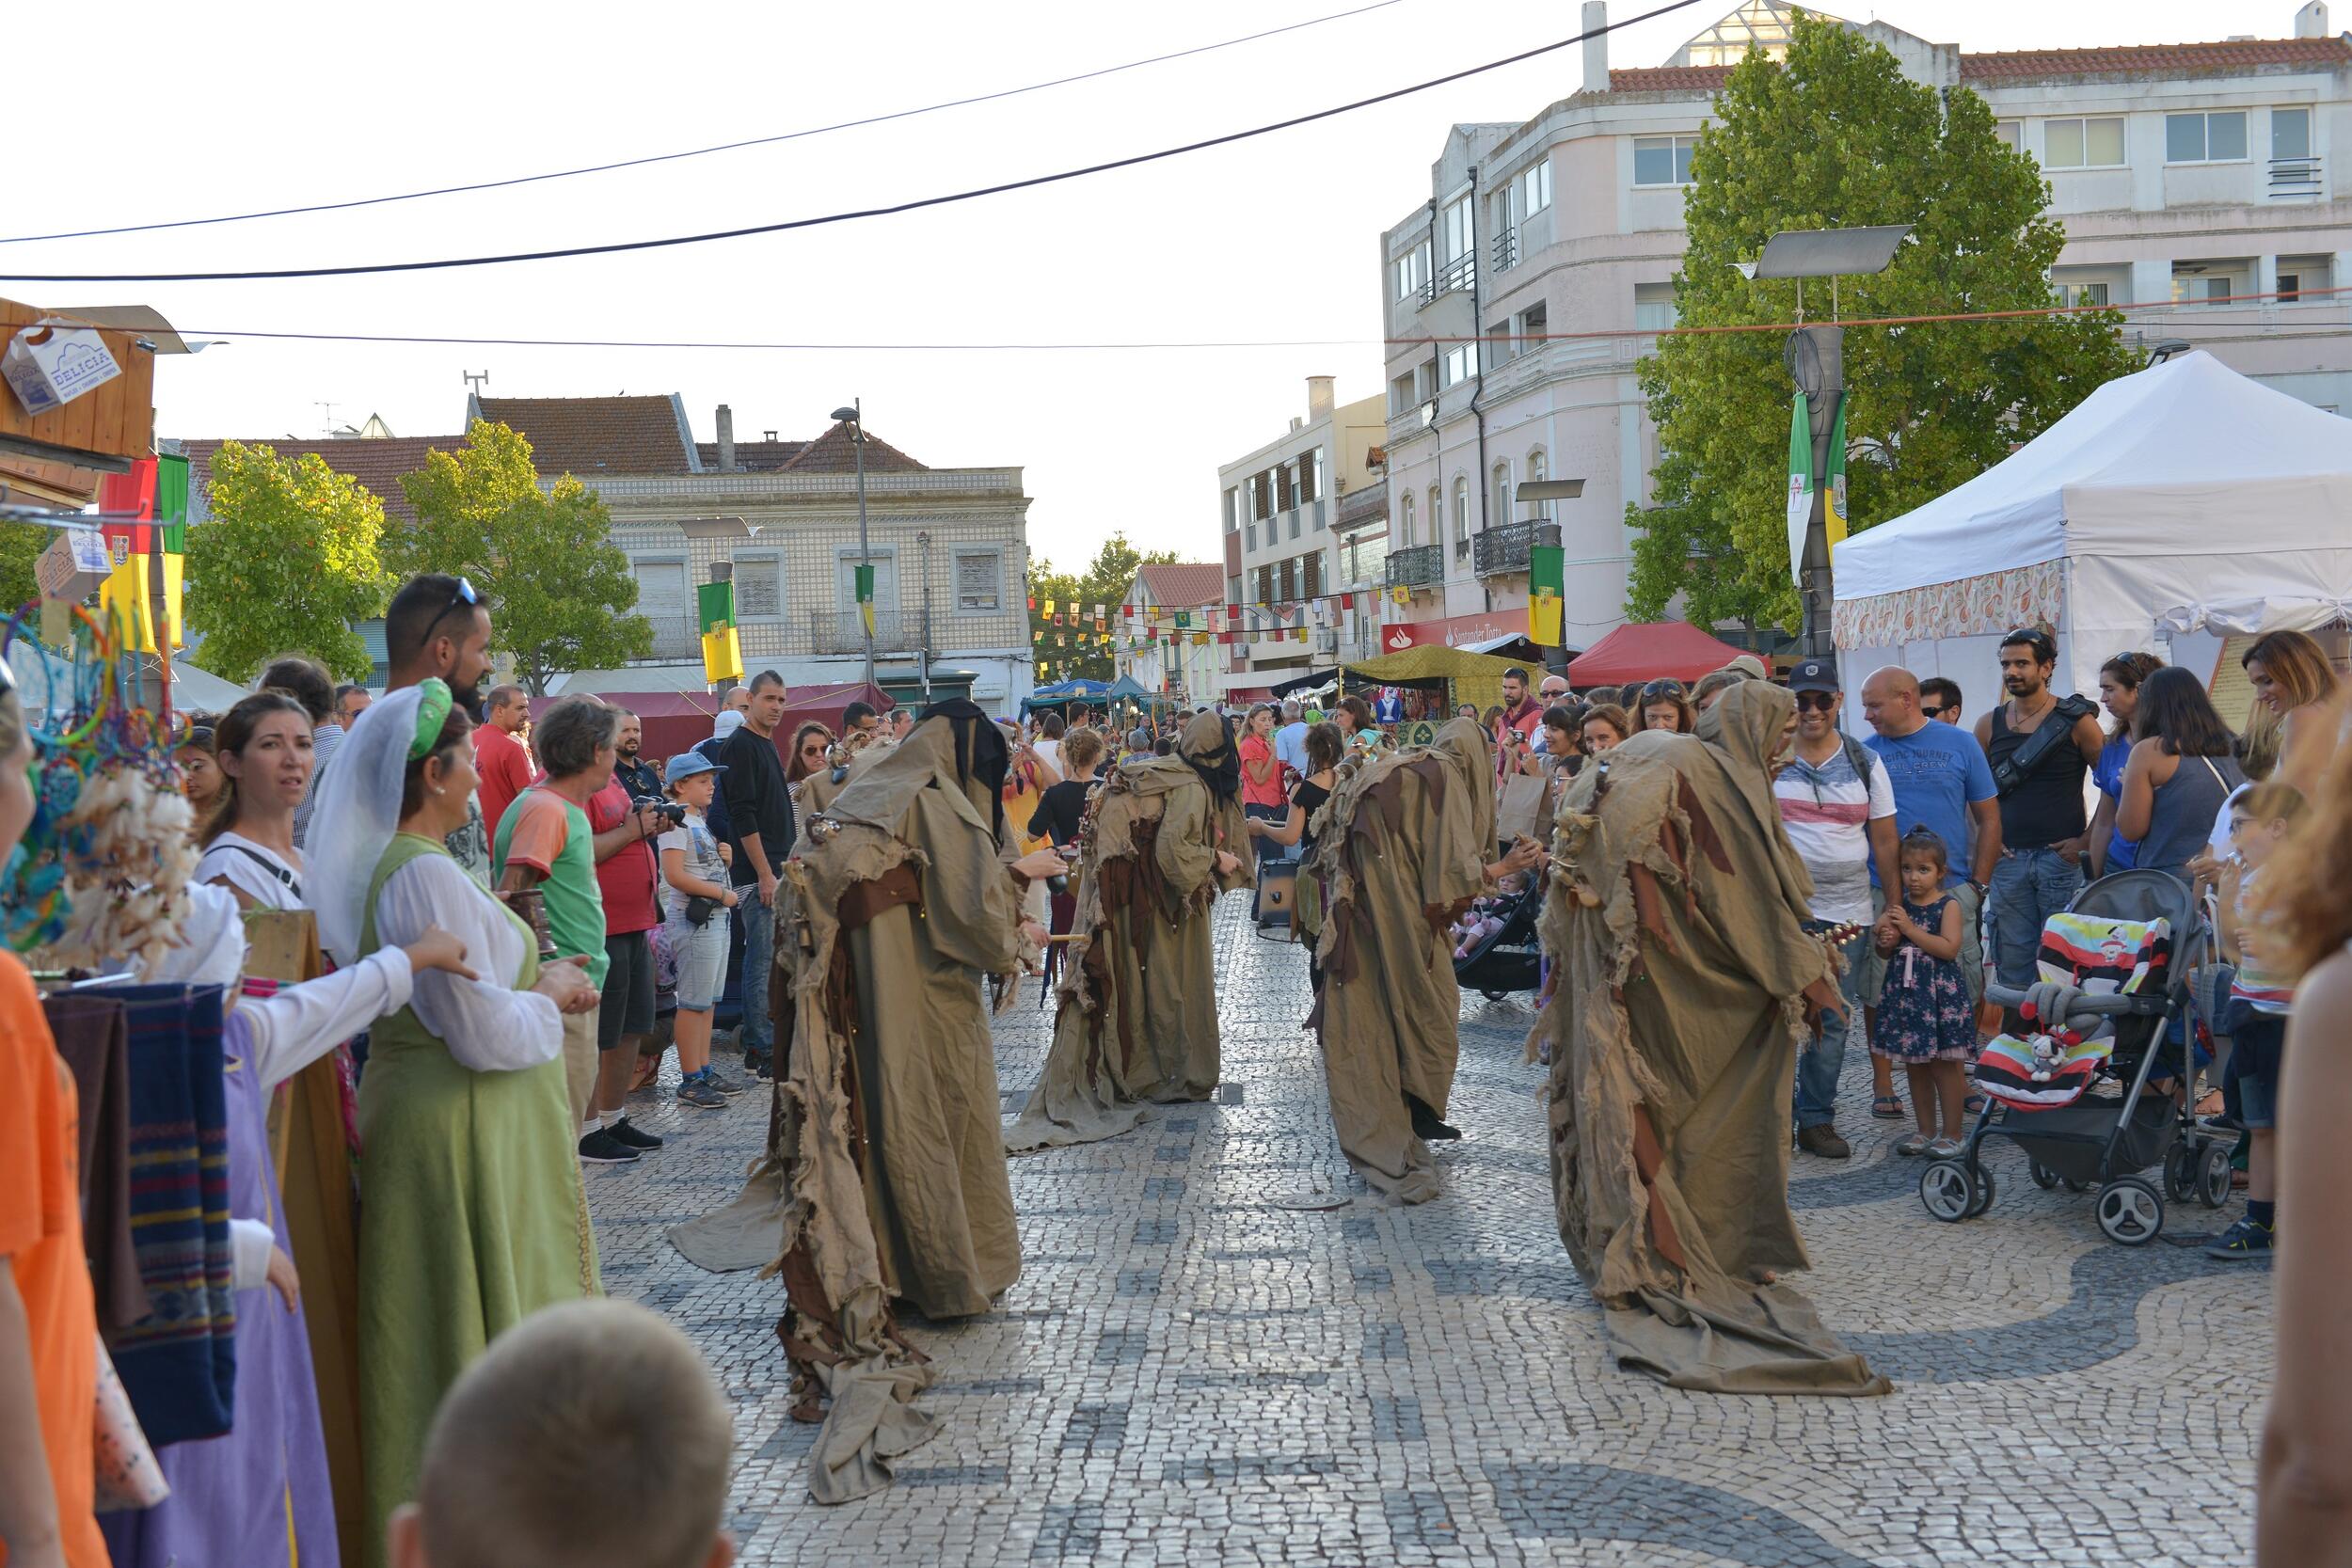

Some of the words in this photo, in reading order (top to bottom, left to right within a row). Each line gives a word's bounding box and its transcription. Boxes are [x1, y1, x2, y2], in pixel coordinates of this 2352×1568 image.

[53, 352, 110, 386] DELICIA
[1454, 624, 1484, 645] Santander
[1912, 749, 1954, 763] JOURNEY
[1913, 761, 1947, 769] CREW
